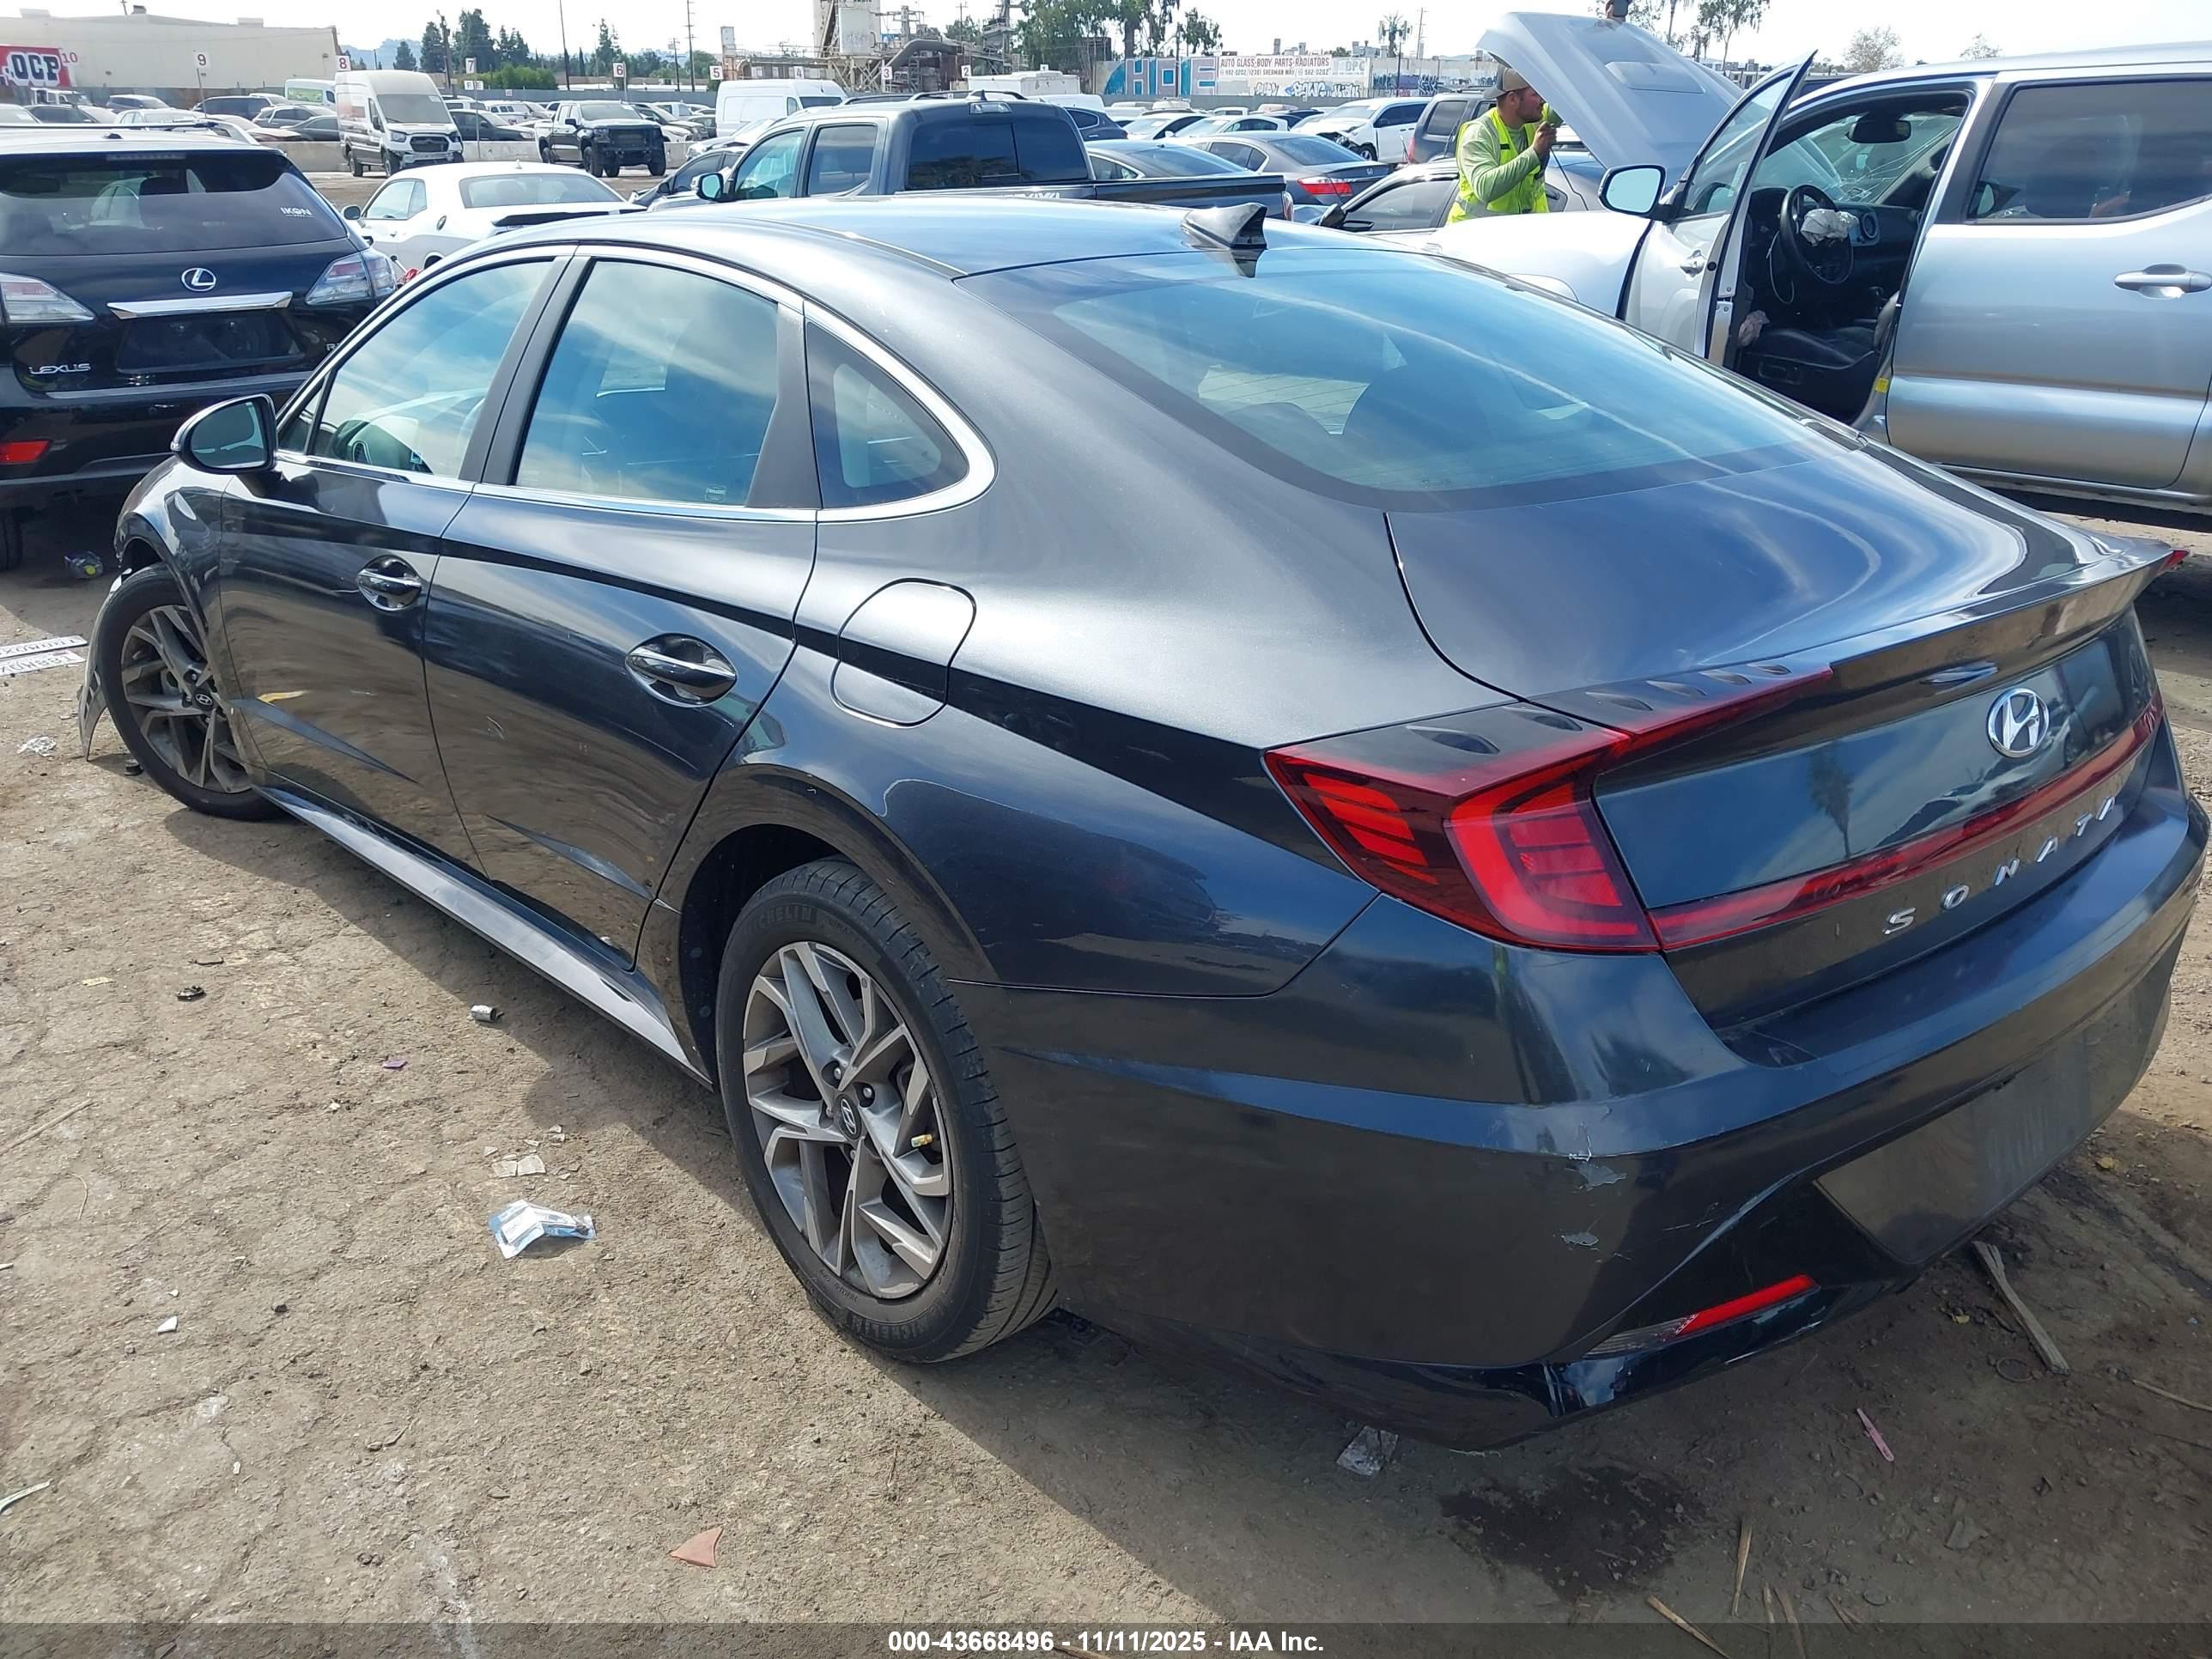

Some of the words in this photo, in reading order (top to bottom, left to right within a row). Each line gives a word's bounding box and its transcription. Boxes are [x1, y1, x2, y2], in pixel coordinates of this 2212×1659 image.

[61, 52, 78, 64] 10
[198, 53, 207, 67] 9
[339, 57, 347, 70] 8
[1220, 58, 1236, 68] AUTO
[9, 53, 60, 82] OCP
[468, 60, 474, 72] 7
[616, 65, 623, 76] 6
[963, 67, 970, 77] 2
[714, 67, 720, 78] 5
[796, 68, 803, 78] 4
[884, 67, 890, 78] 3
[28, 362, 92, 375] LEXUS
[1882, 795, 2118, 935] SONATA
